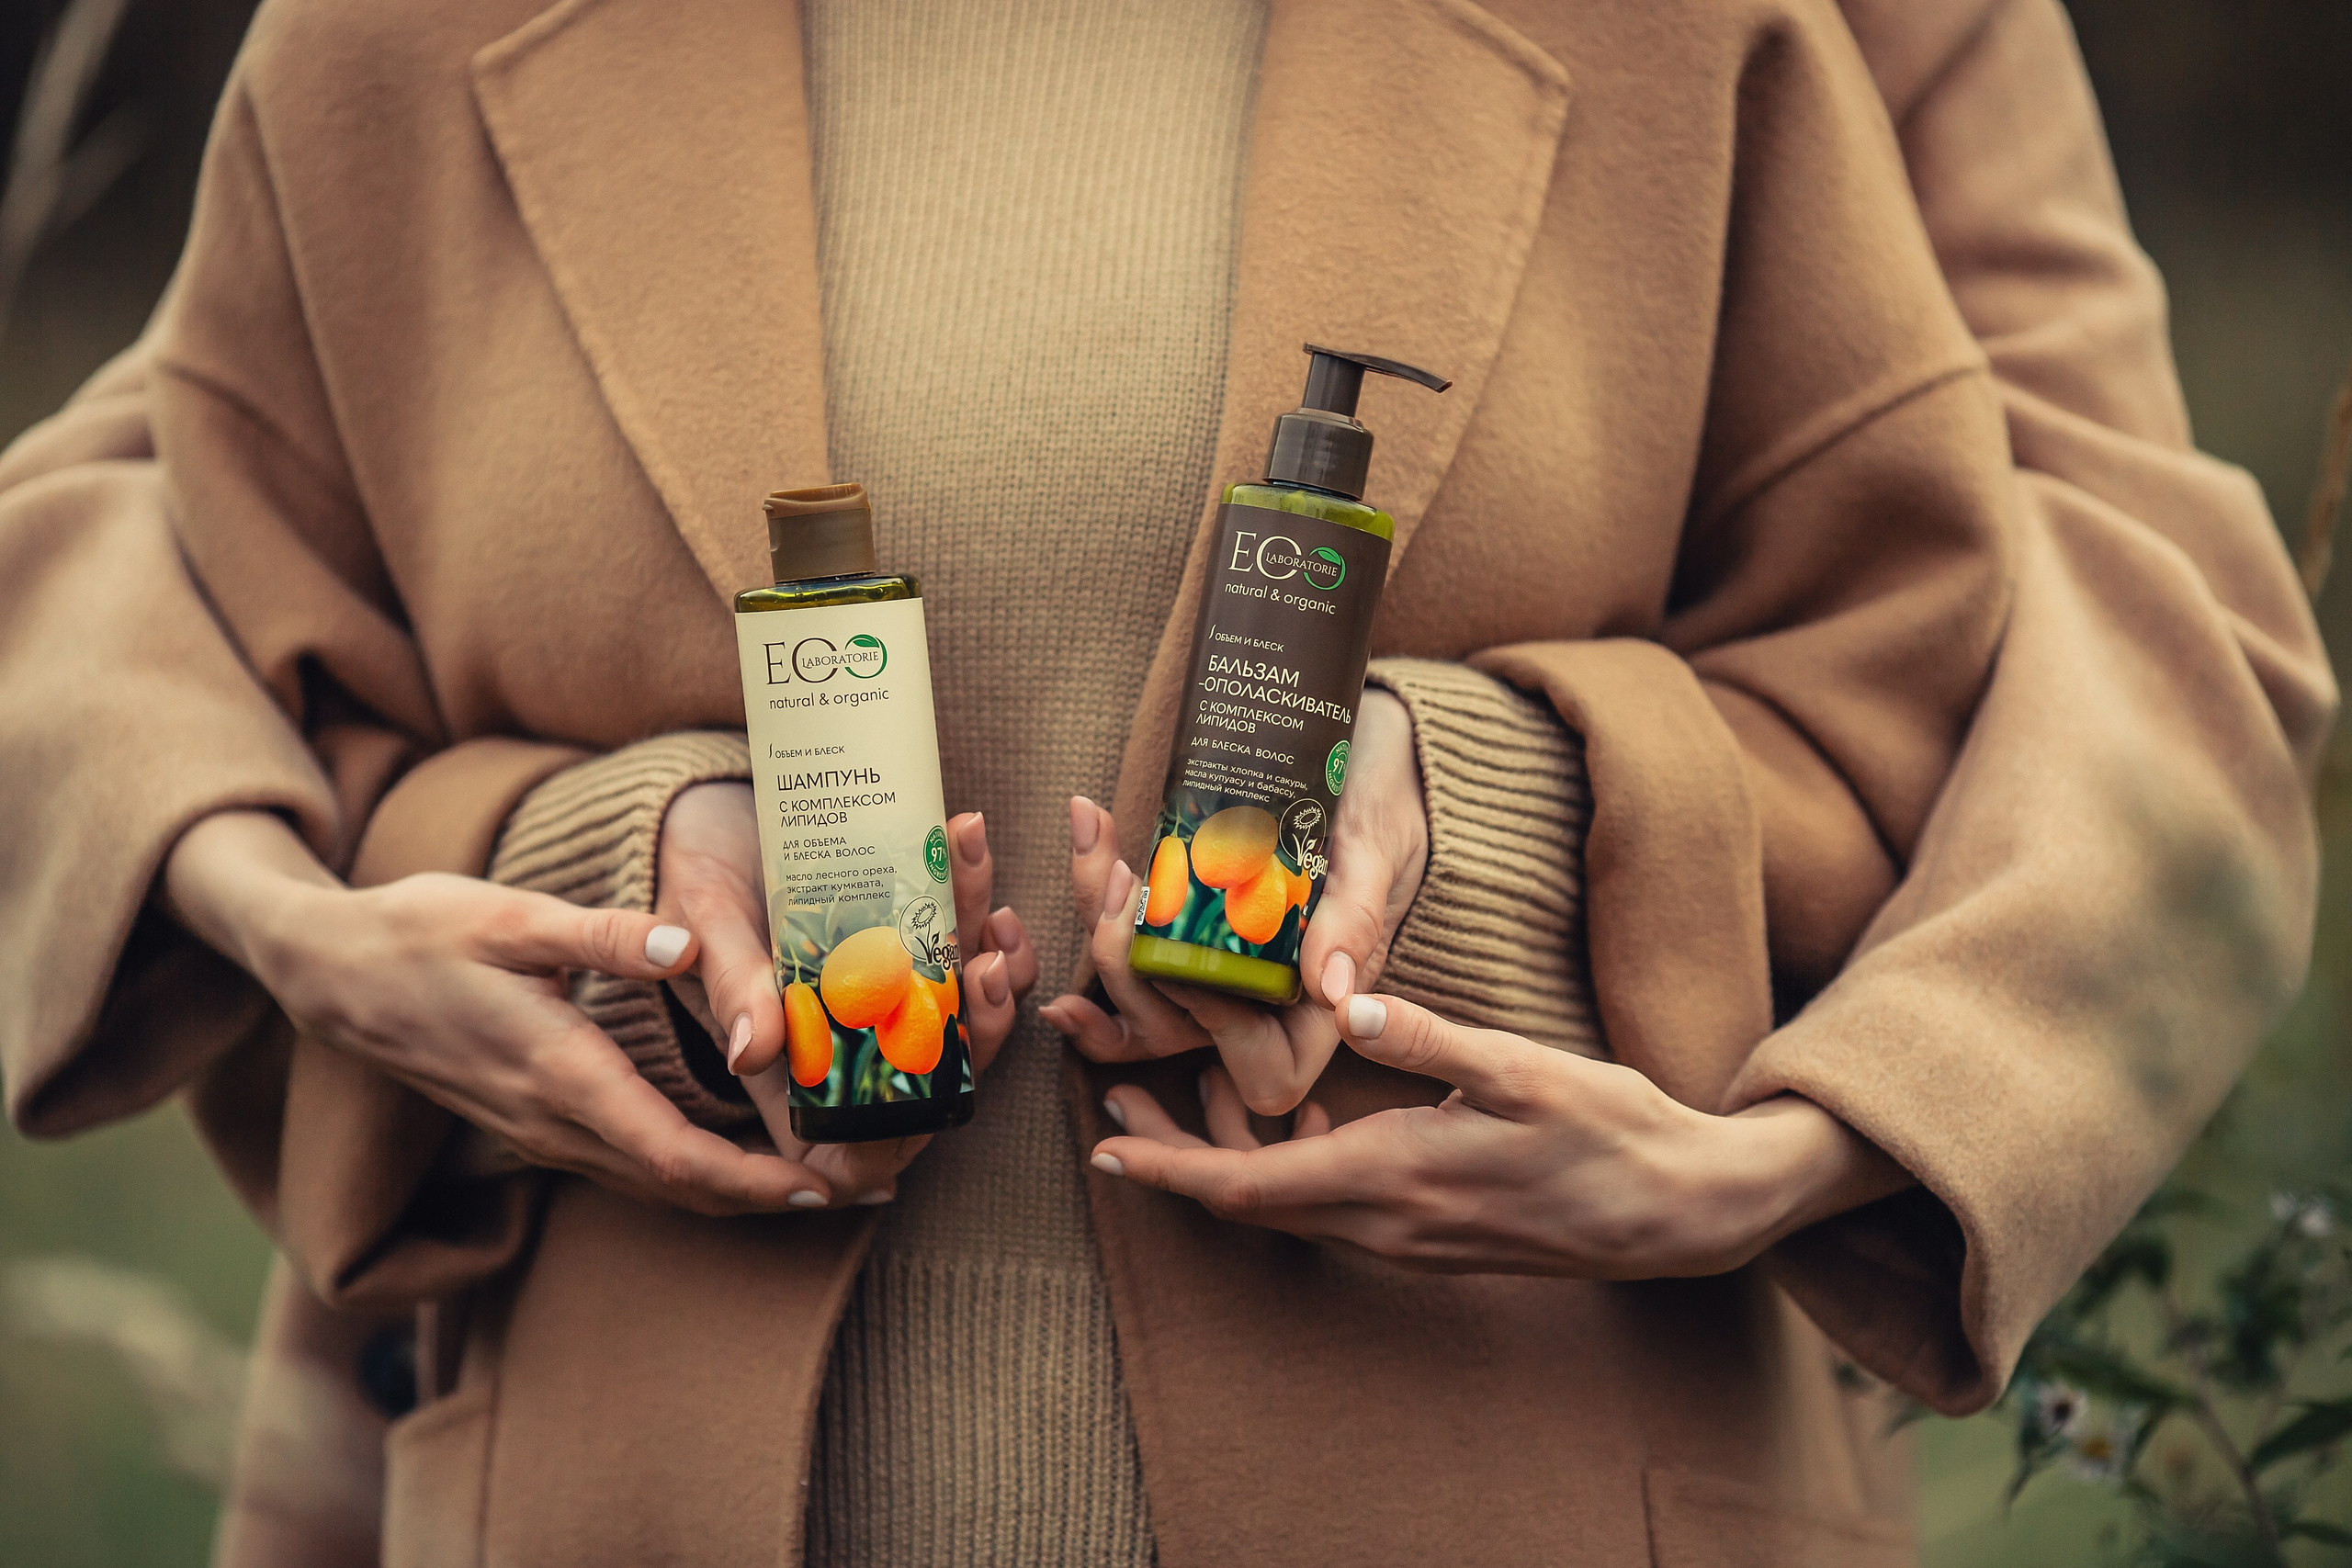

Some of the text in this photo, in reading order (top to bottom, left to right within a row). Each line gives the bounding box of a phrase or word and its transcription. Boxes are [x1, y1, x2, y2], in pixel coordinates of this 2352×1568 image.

[1266, 552, 1337, 577] LABORATORIE
[1225, 582, 1336, 614] natural & organic
[1215, 633, 1242, 643] ОБЪЕМ
[1253, 639, 1284, 652] БЛЕСК
[802, 651, 879, 669] LABORATORIE
[1208, 655, 1300, 687] БАЛЬЗАМ
[770, 688, 889, 709] natural & organic
[1199, 677, 1351, 724] -ОПОЛАСКИВАТЕЛЬ
[1196, 714, 1256, 733] ЛИПИДОВ
[1200, 700, 1304, 730] С КОМПЛЕКСОМ
[775, 746, 845, 758] ОБЪЕМ И БЛЕСК
[1191, 737, 1294, 765] ДЛЯ БЛЕСКА ВОЛОС
[777, 768, 880, 791] ШАМПУНЬ
[1185, 769, 1207, 778] масла
[1209, 773, 1245, 787] купуасу
[1257, 780, 1296, 798] бабассу,
[1187, 759, 1228, 772] экстракты
[1230, 764, 1265, 779] хлопка
[1275, 775, 1307, 790] сакуры,
[1182, 779, 1270, 803] липидный комплекс
[779, 792, 896, 812] С КОМПЛЕКСОМ
[781, 812, 847, 827] ЛИПИДОВ
[783, 837, 846, 850] ДЛЯ ОБЪЕМА
[784, 846, 875, 860] И БЛЕСКА ВОЛОС
[786, 866, 897, 882] масло лесного ореха,
[787, 880, 883, 894] экстракт кумквата,
[788, 891, 890, 905] липидный комплекс
